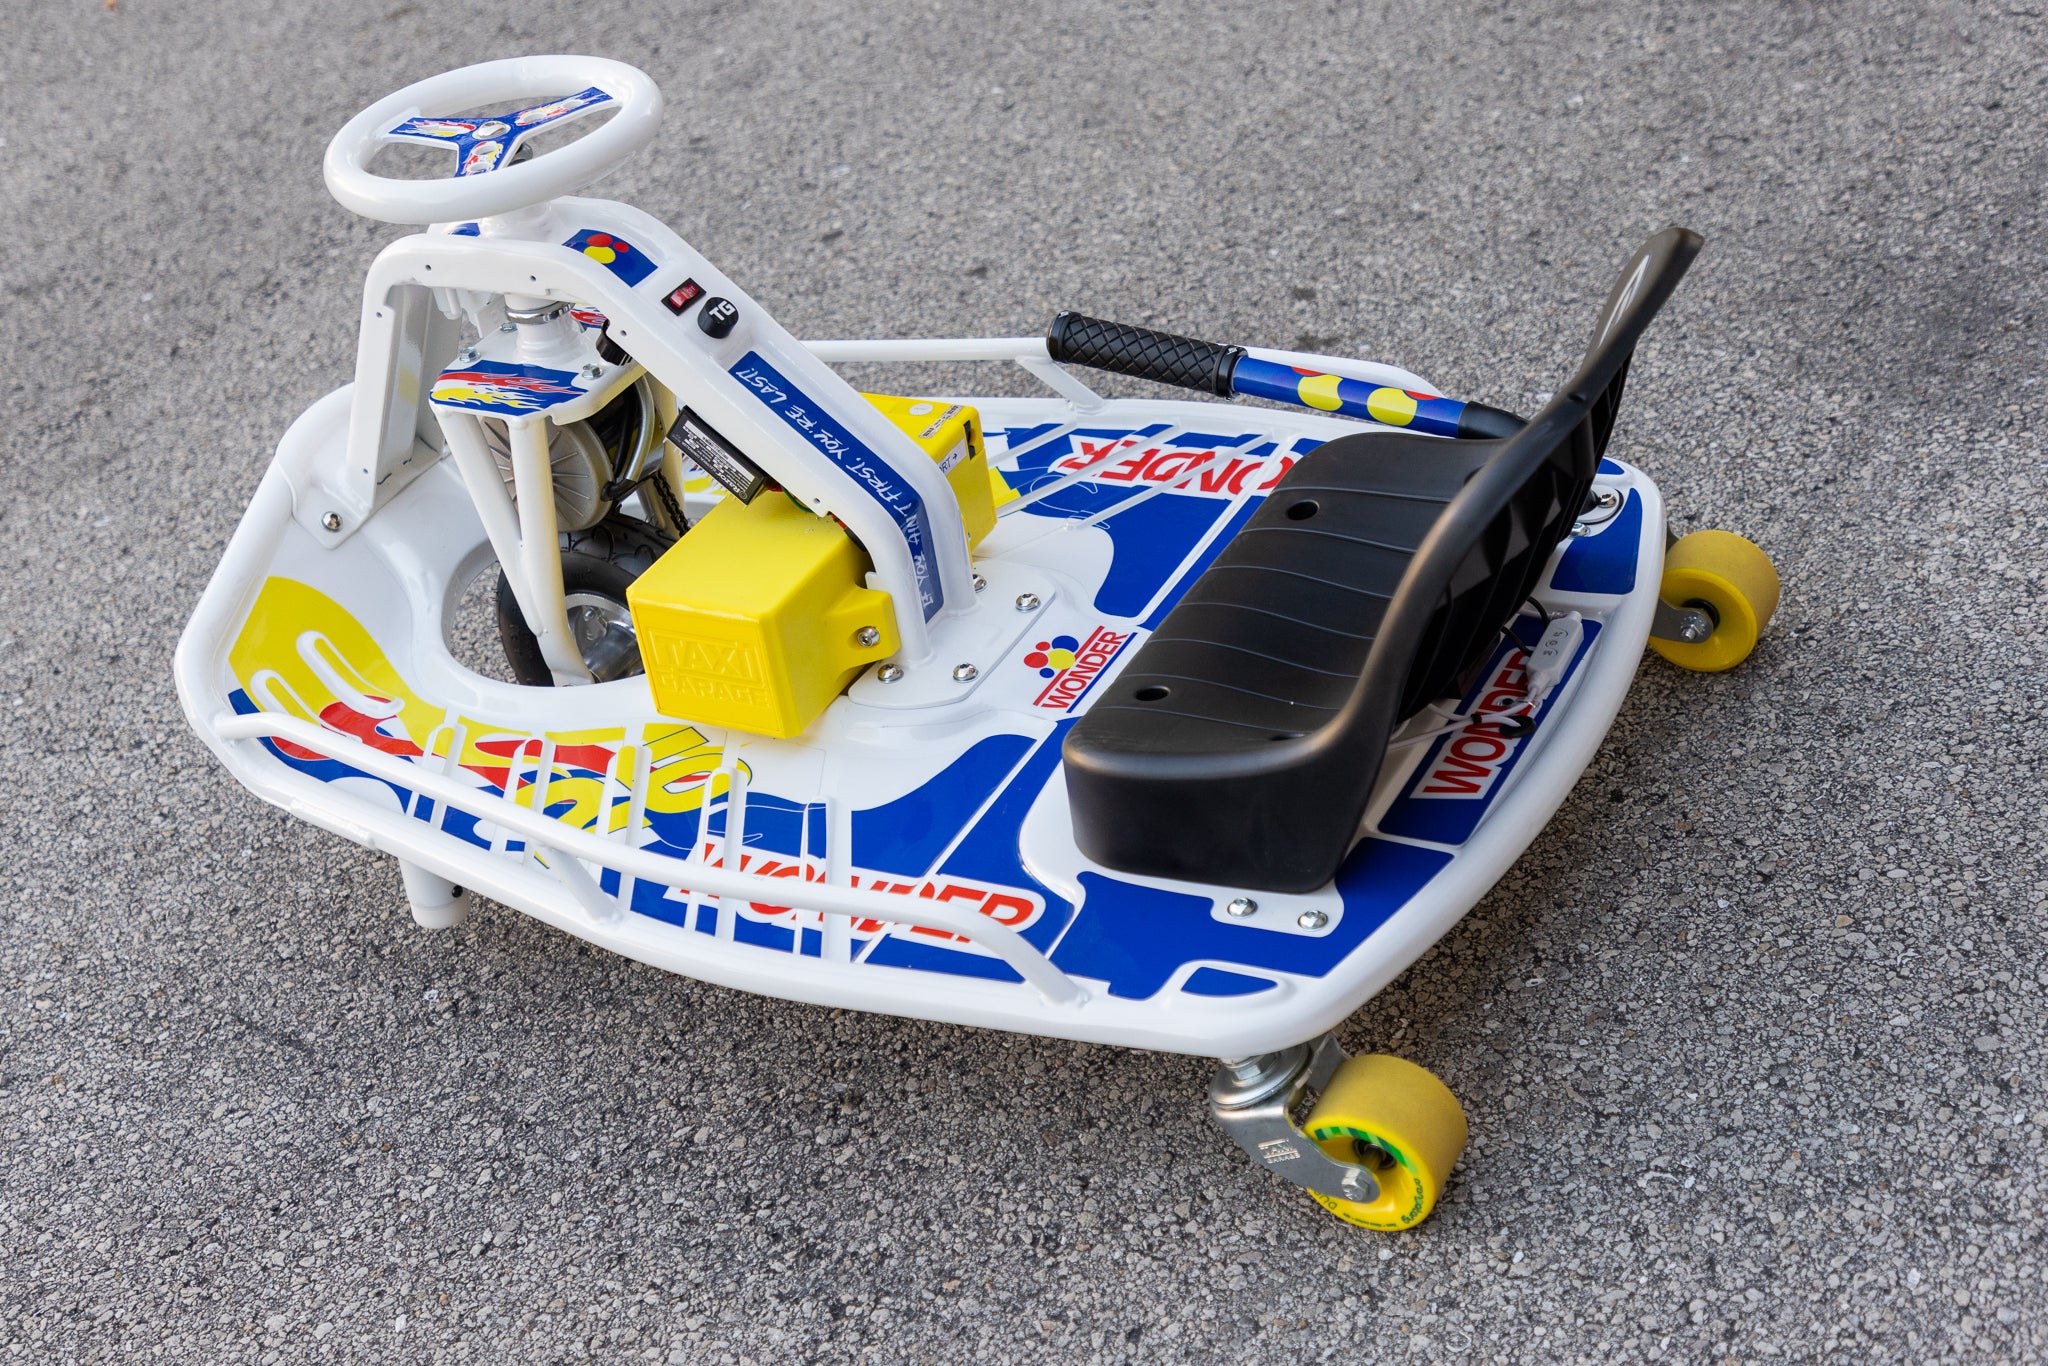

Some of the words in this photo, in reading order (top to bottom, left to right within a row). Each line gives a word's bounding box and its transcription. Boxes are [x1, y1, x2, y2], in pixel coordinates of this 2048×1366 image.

[736, 366, 789, 405] LAST!
[784, 404, 850, 461] YOU'RE
[845, 456, 902, 503] FIRST,
[1057, 438, 1295, 497] ONDER
[893, 502, 922, 546] AIN'T
[913, 554, 930, 587] YOU
[917, 591, 934, 608] IF
[646, 627, 765, 690] TAXI
[1041, 631, 1130, 709] WONDER
[661, 667, 771, 709] GARAGE
[679, 842, 1035, 944] WODER
